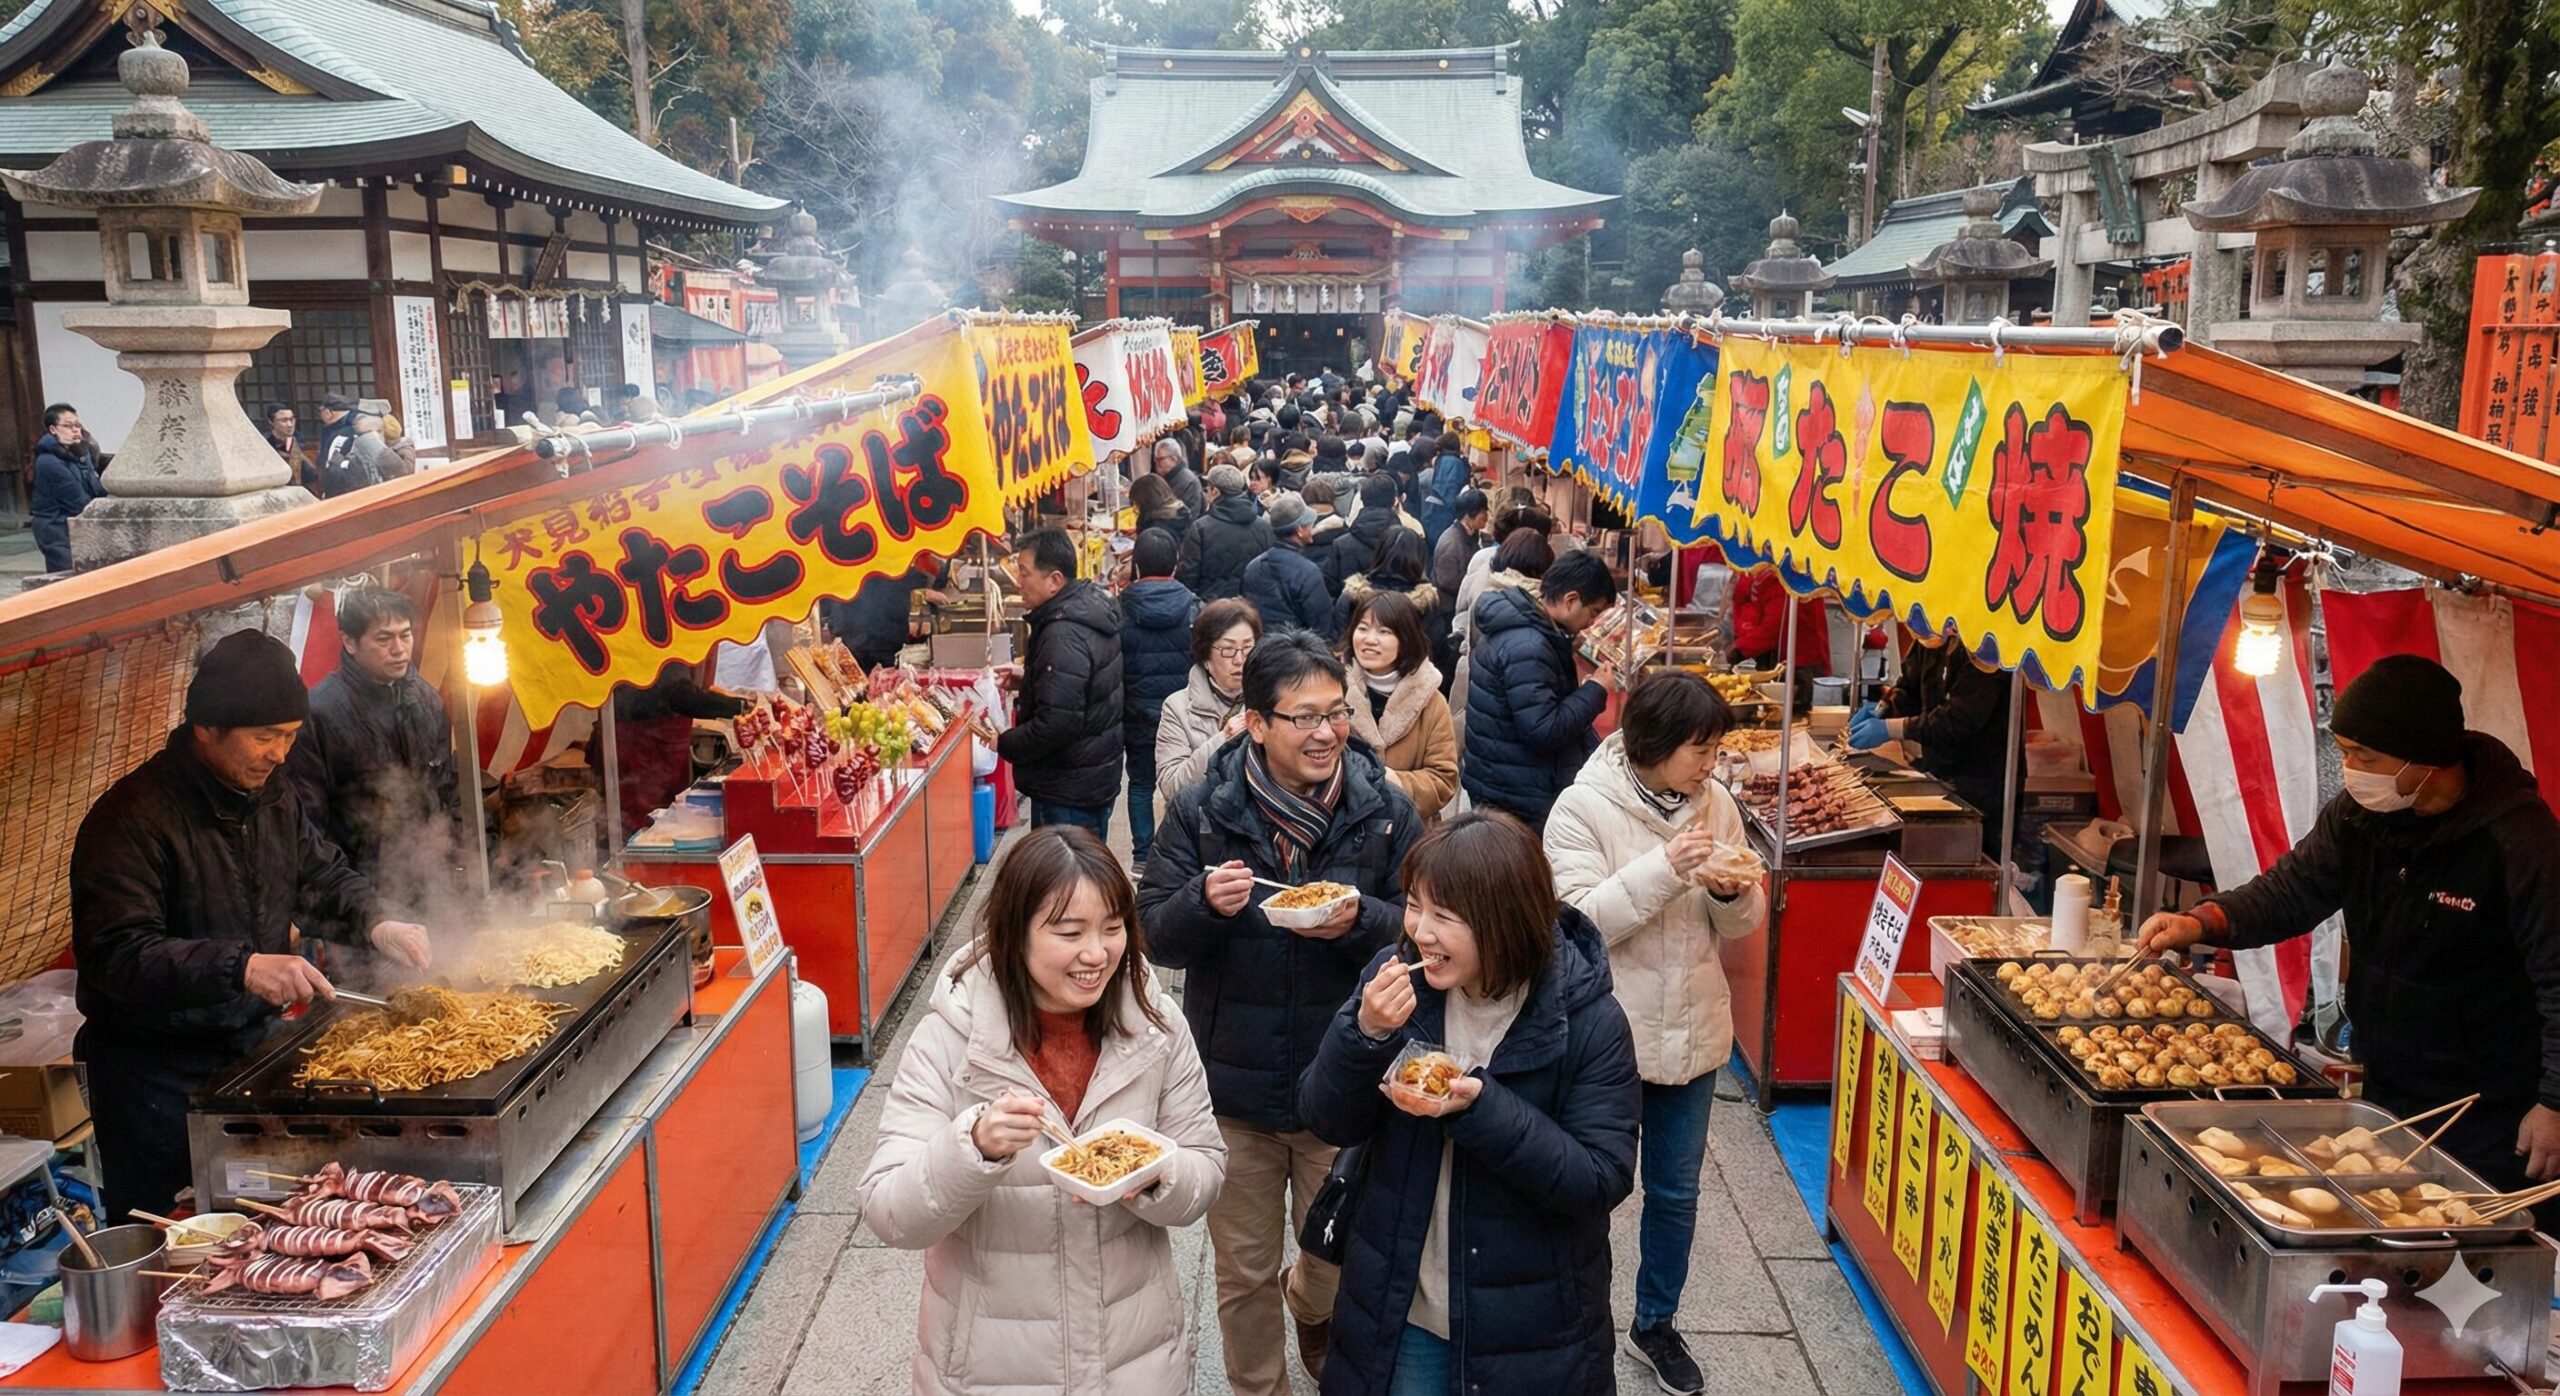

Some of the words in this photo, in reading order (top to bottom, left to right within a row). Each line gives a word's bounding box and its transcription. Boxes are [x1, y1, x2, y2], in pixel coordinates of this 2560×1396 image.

[526, 393, 968, 678] やたこそば
[2020, 1232, 2048, 1396] たこめん
